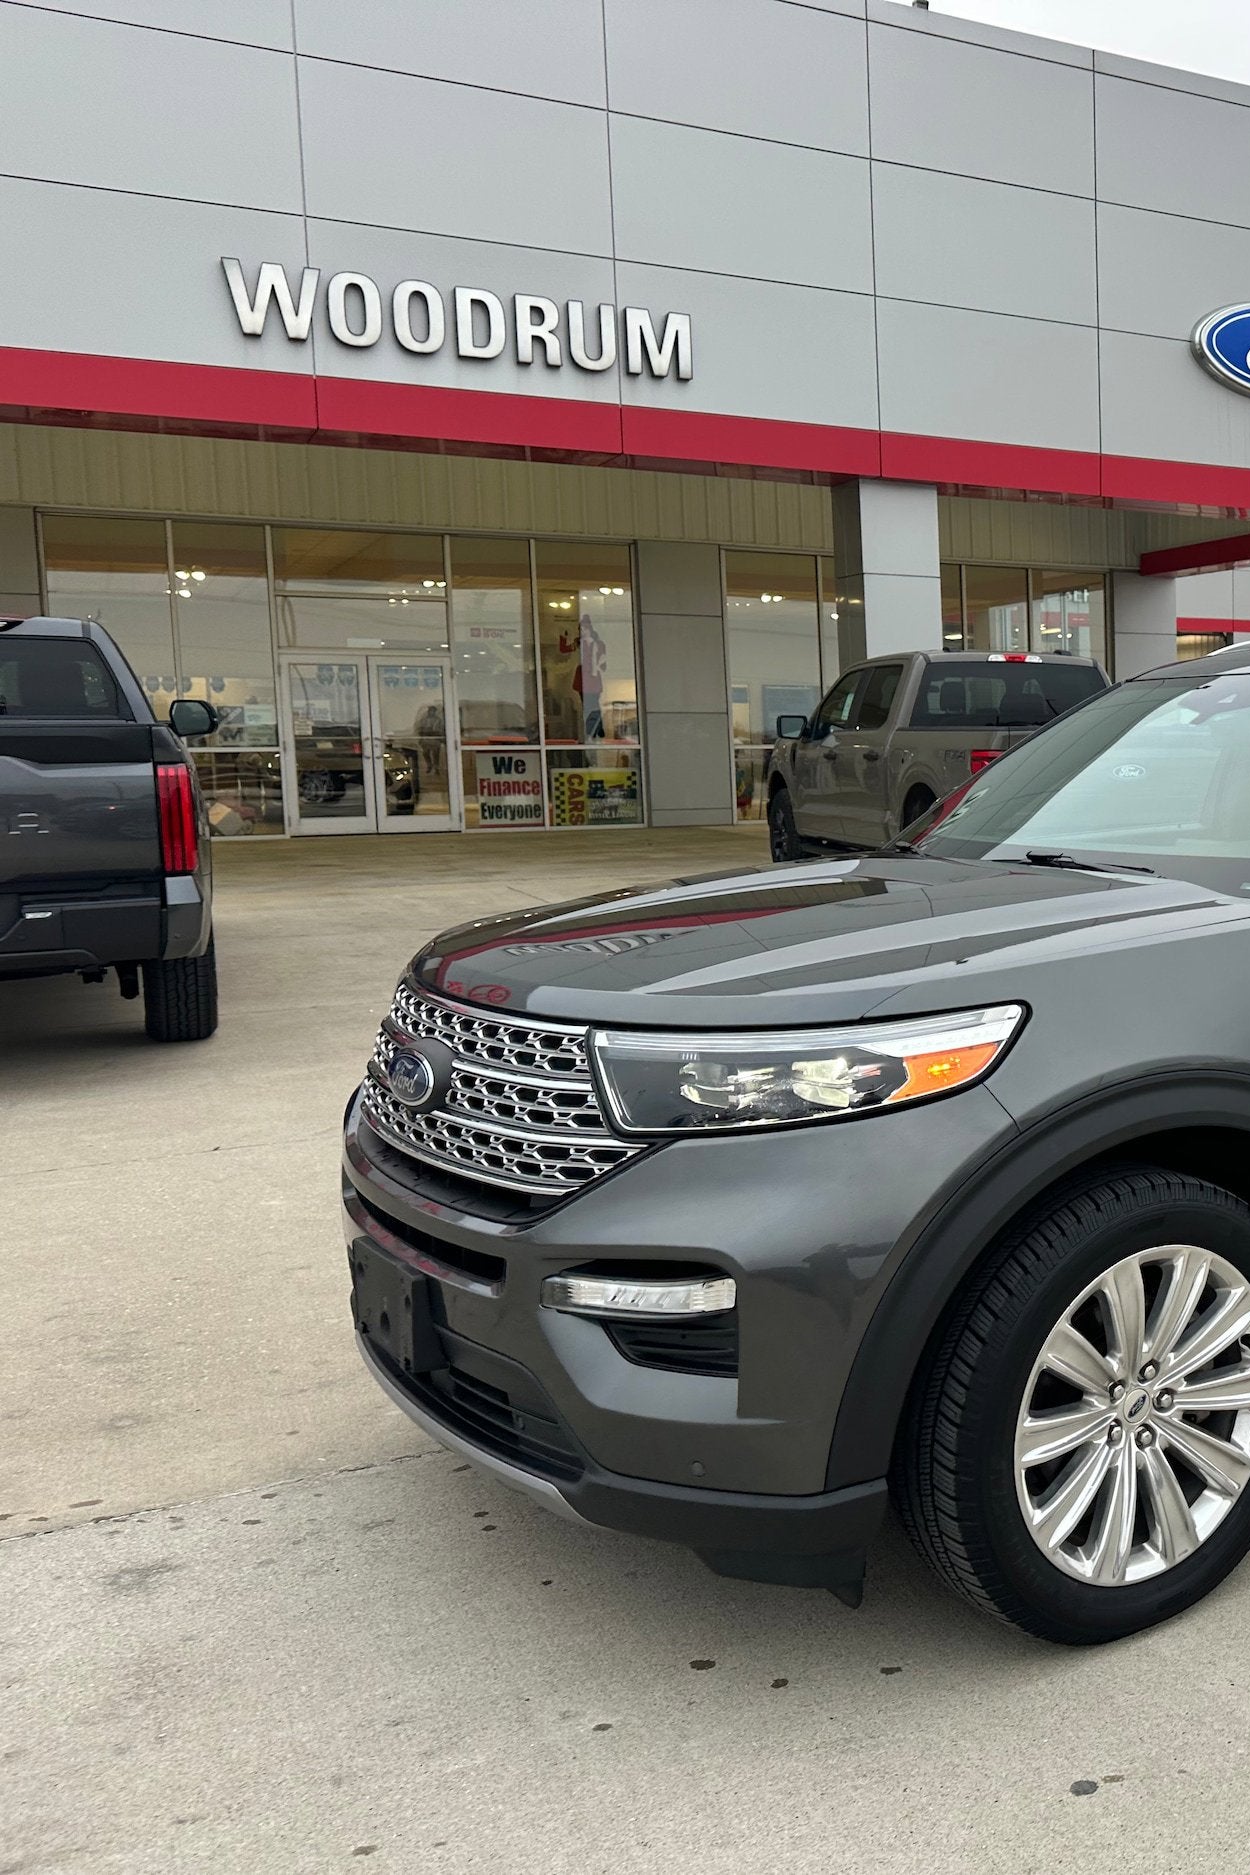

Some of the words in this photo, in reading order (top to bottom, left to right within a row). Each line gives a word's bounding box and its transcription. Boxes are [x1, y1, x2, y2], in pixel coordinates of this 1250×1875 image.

[220, 256, 694, 381] WOODRUM
[492, 756, 526, 774] We
[479, 778, 540, 797] Finance
[567, 773, 585, 826] CARS
[480, 802, 541, 821] Everyone
[391, 1059, 419, 1094] Ford
